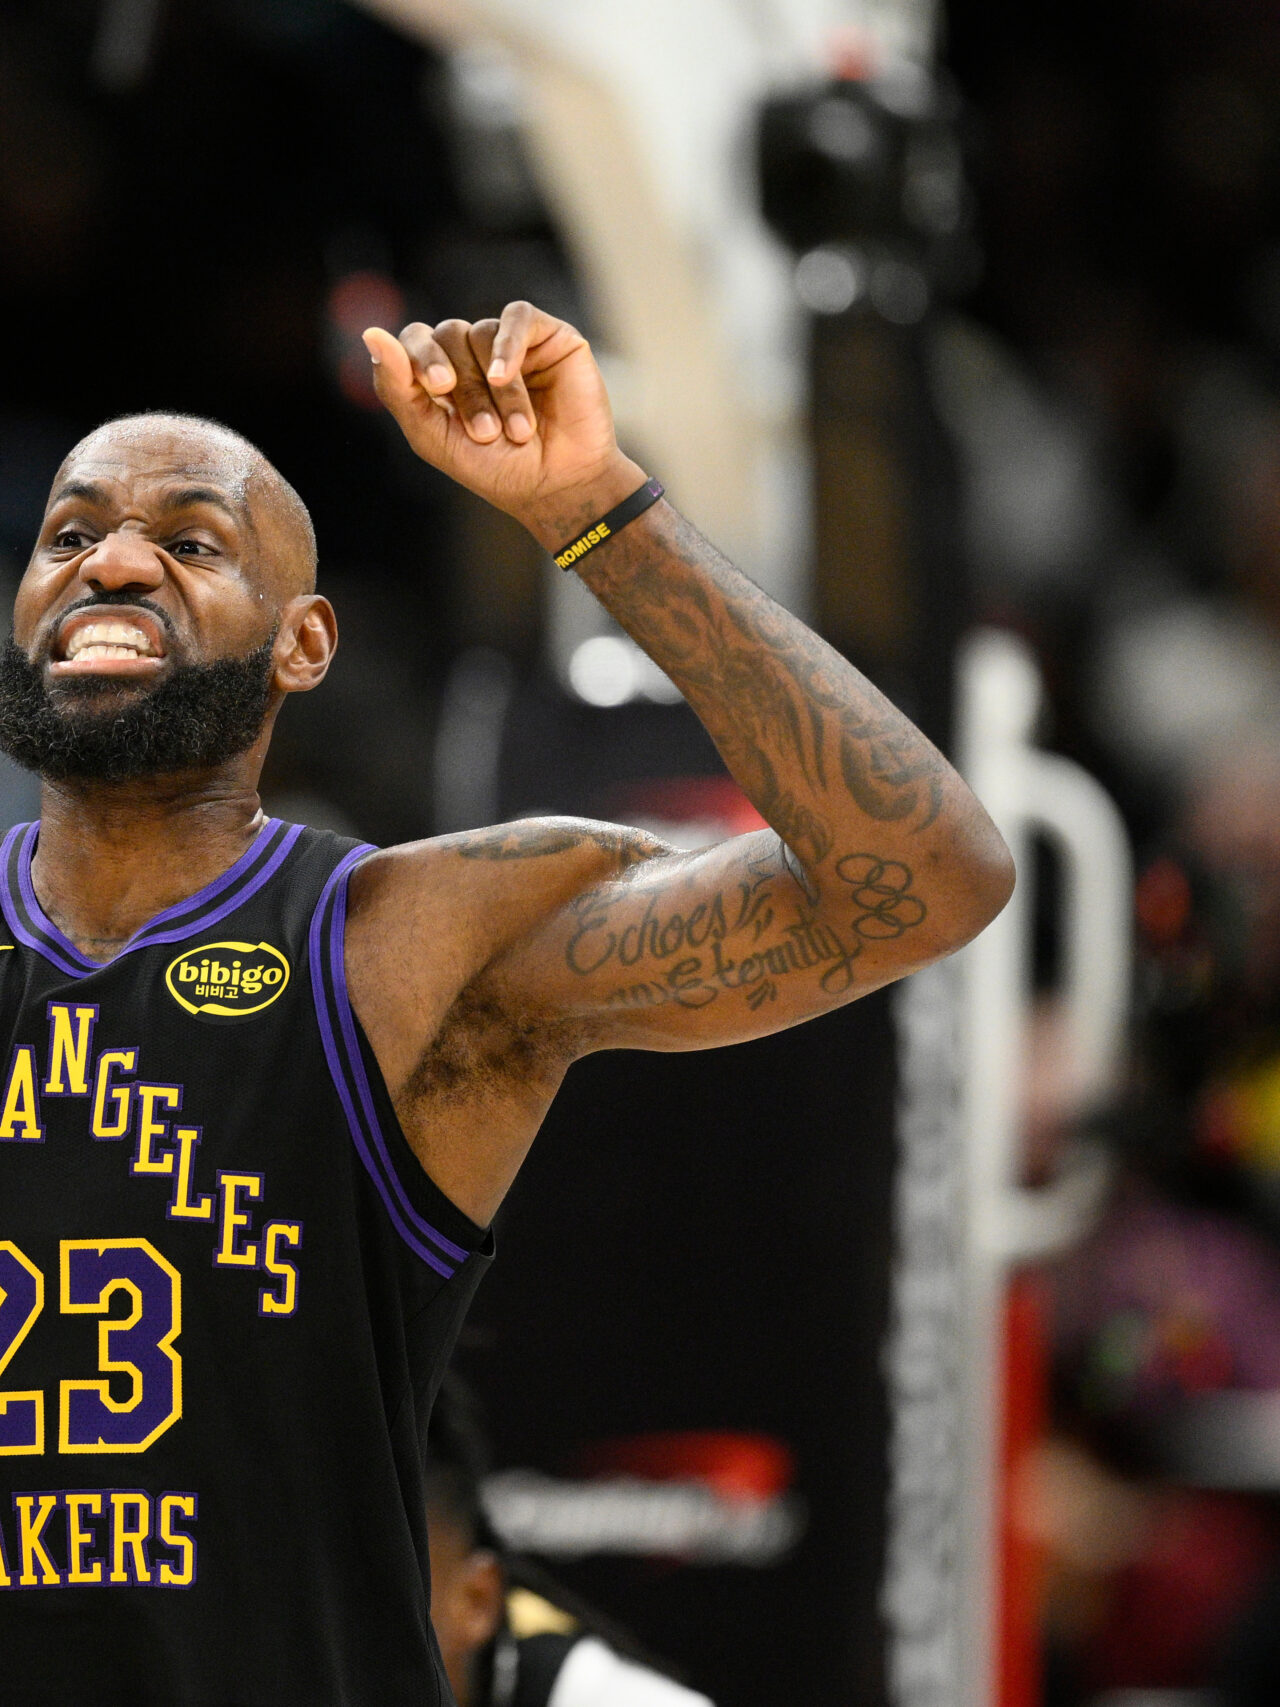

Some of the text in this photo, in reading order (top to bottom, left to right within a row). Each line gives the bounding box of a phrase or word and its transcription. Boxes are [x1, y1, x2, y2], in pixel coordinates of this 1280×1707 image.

[554, 522, 612, 569] ROMISE
[565, 889, 727, 975] Echoes
[179, 959, 283, 994] bibigo
[665, 904, 863, 1009] Eternity
[195, 984, 239, 999] 비비고
